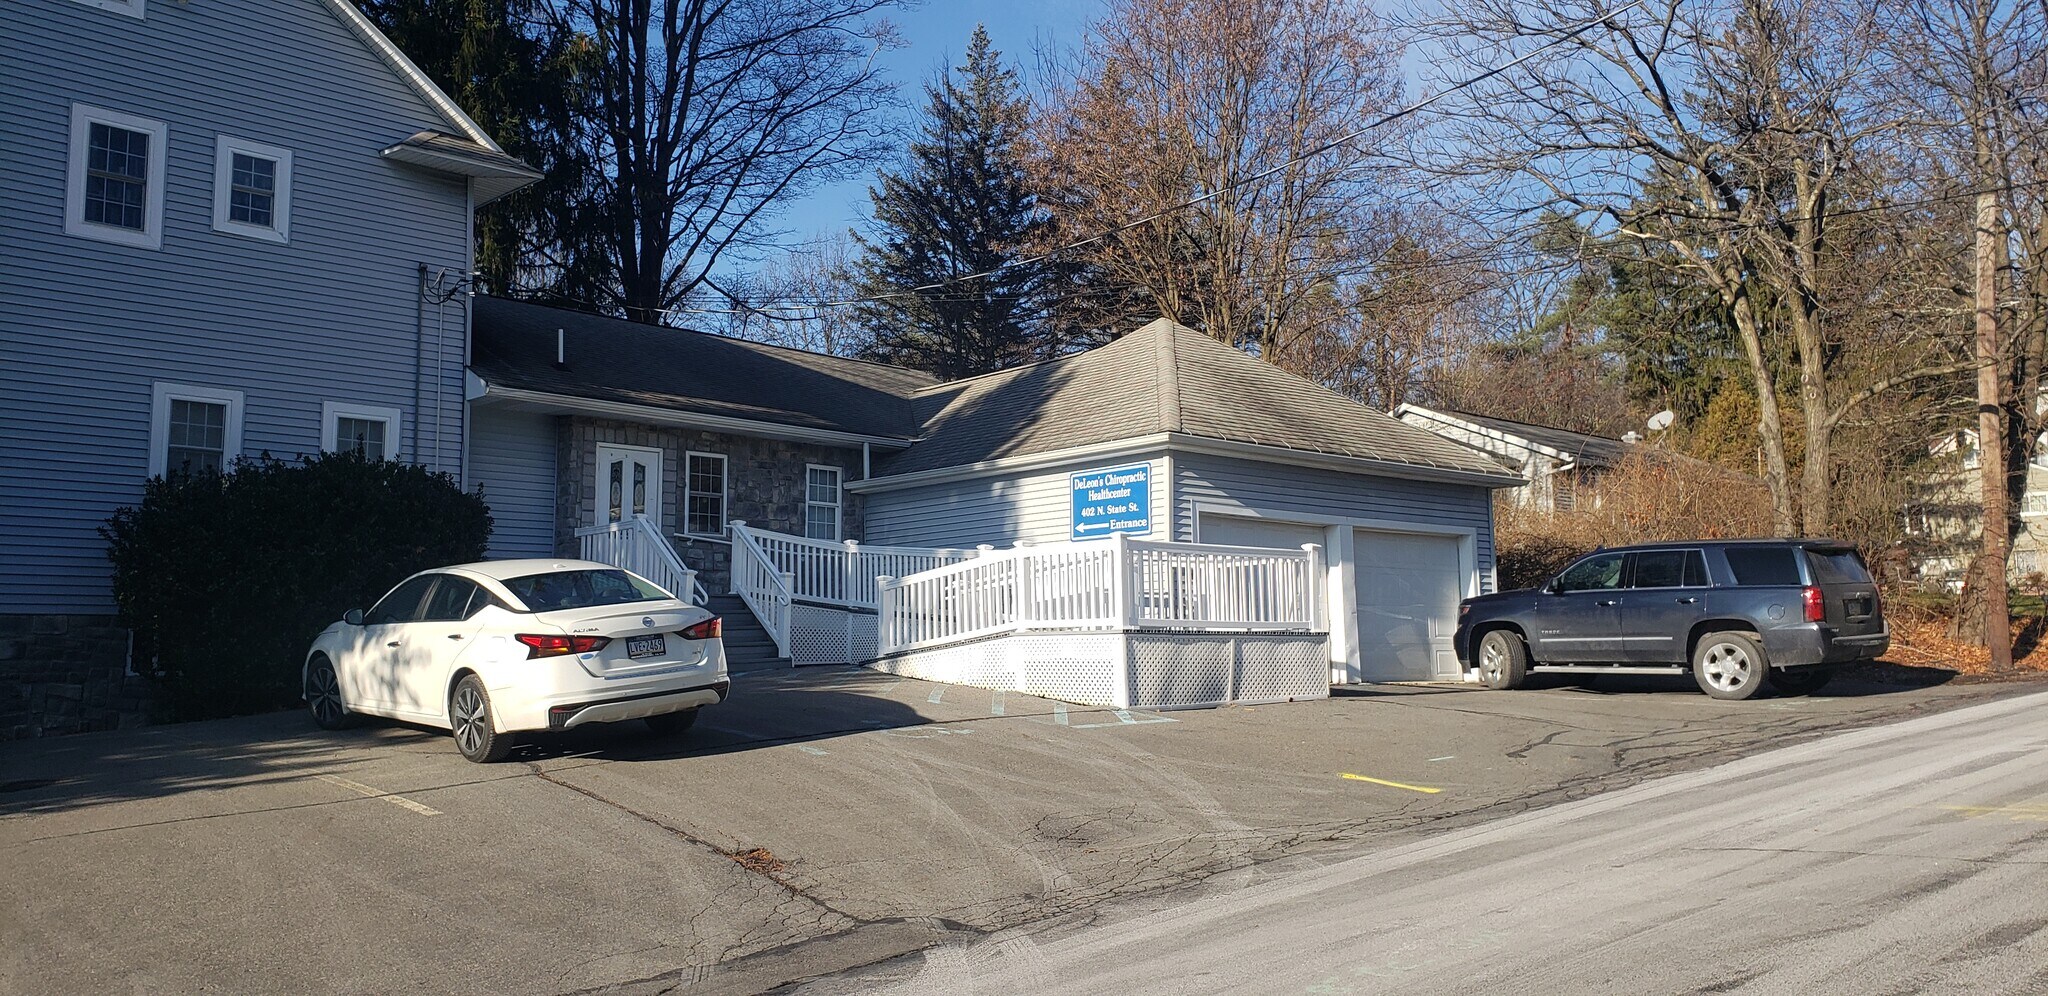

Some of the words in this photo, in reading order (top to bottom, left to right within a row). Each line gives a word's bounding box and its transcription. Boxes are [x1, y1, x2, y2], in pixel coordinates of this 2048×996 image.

[1074, 476, 1103, 490] DeLeon's
[1105, 471, 1146, 486] Chiropractic
[1088, 488, 1131, 501] Healthcenter
[1081, 507, 1095, 517] 402
[1097, 506, 1105, 515] N.
[1107, 505, 1126, 514] State
[1128, 502, 1139, 511] St.
[1110, 519, 1147, 529] Entrance
